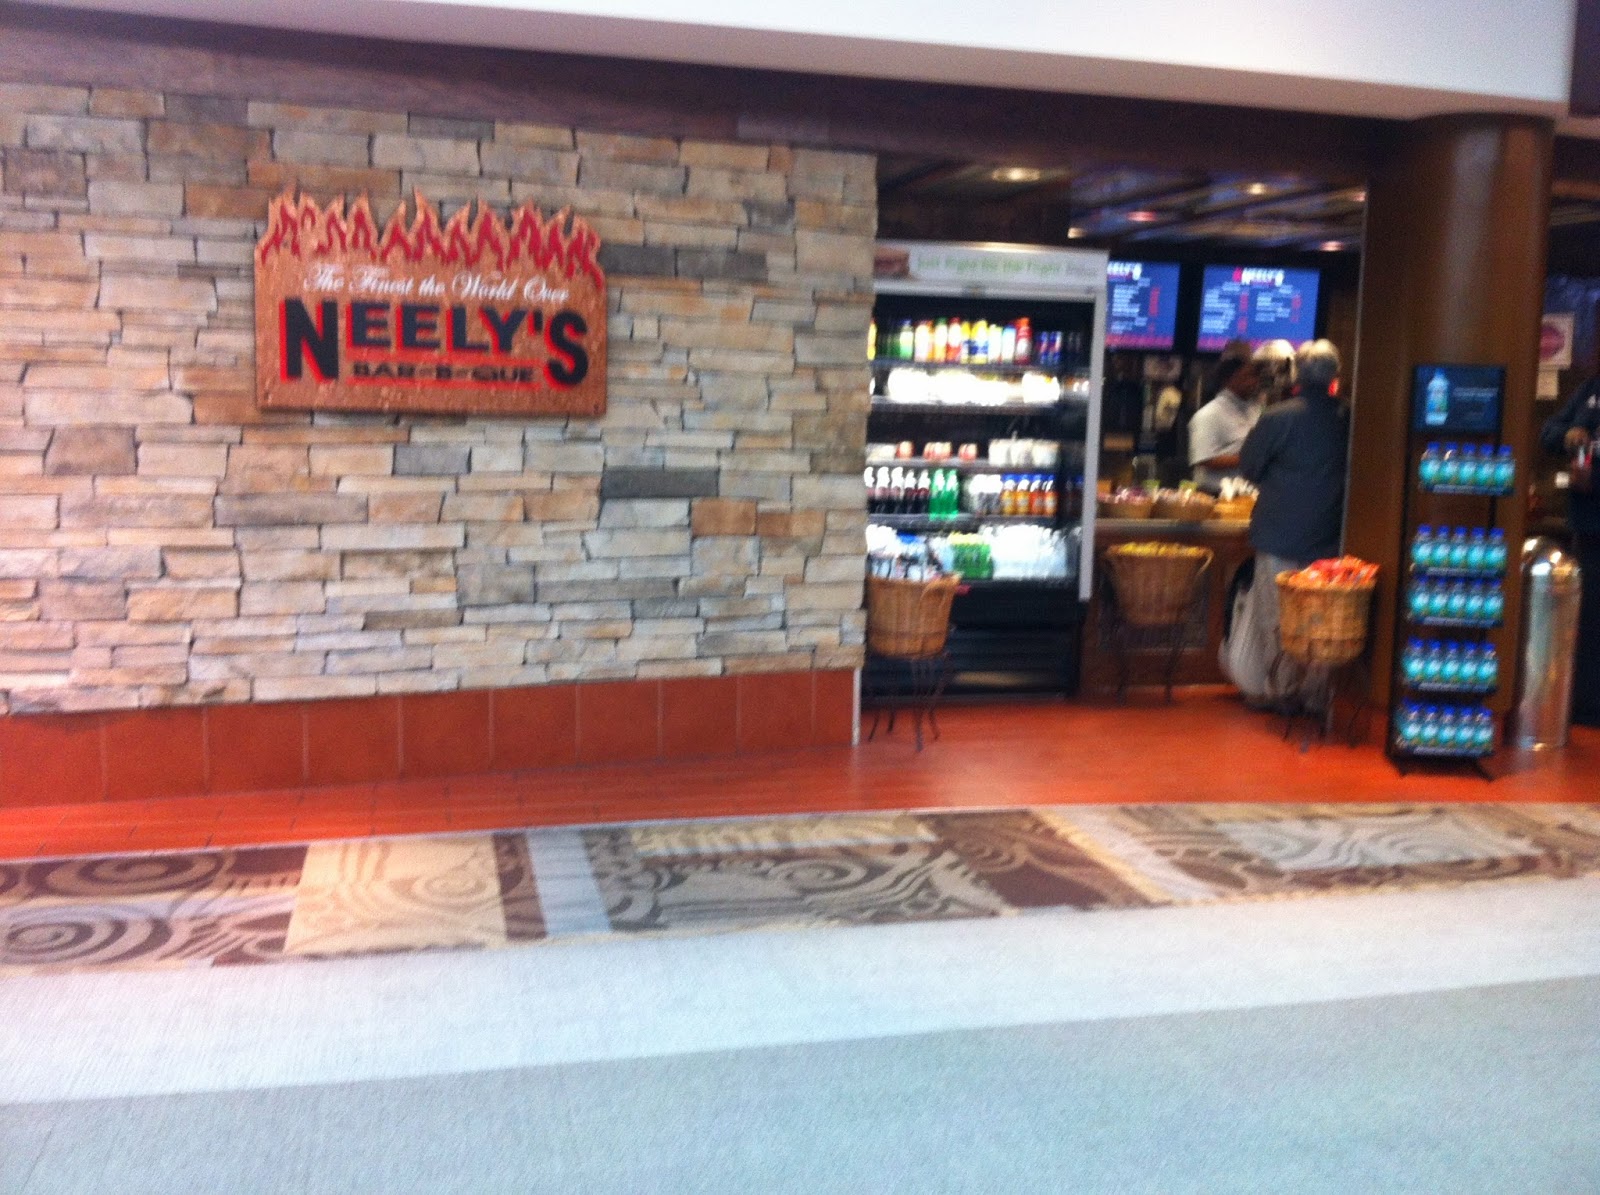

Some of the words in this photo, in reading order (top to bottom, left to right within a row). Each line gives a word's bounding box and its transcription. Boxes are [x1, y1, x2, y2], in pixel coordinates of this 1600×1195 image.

[303, 263, 345, 293] The
[349, 264, 414, 296] Finest
[418, 274, 446, 298] the
[451, 270, 519, 300] World
[522, 275, 570, 303] Over
[280, 297, 588, 390] NEELY'S
